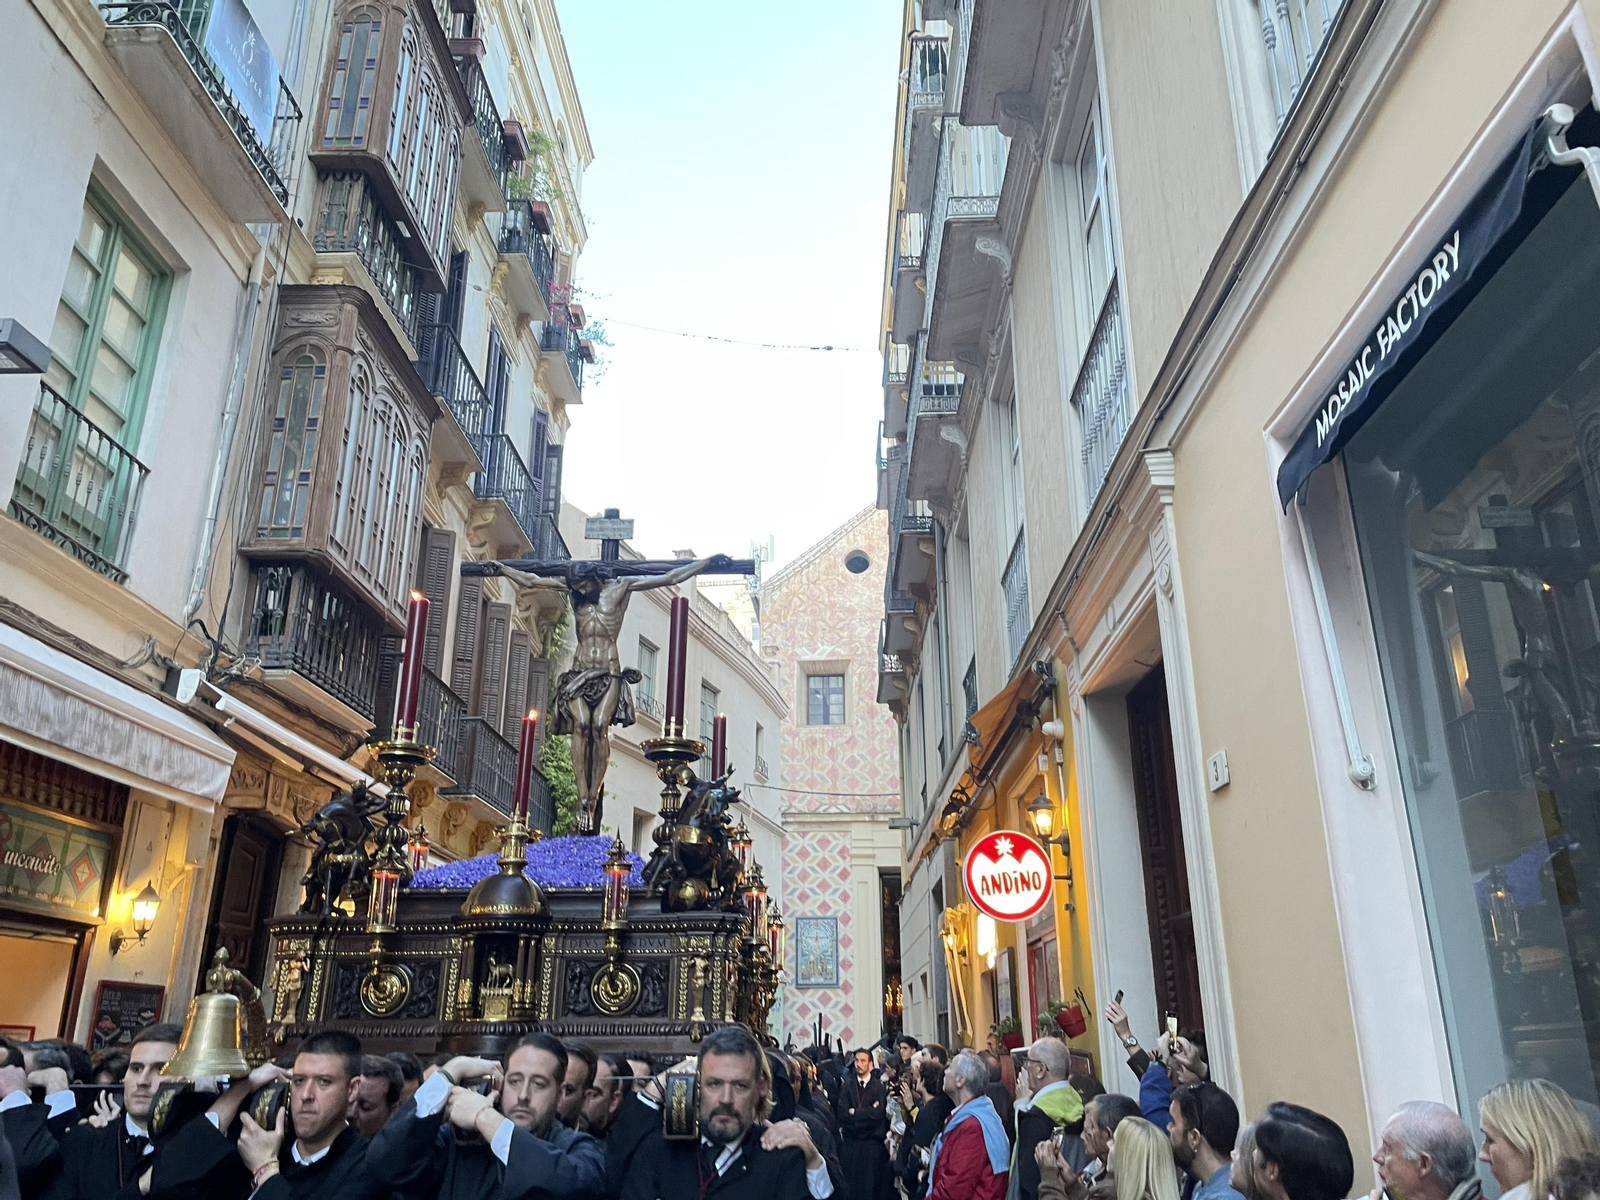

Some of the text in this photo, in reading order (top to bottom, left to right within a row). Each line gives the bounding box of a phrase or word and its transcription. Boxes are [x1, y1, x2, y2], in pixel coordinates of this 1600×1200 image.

[226, 37, 263, 98] PINEAPPLE
[1316, 230, 1460, 448] MOSAIC FACTORY
[1213, 760, 1219, 782] 3
